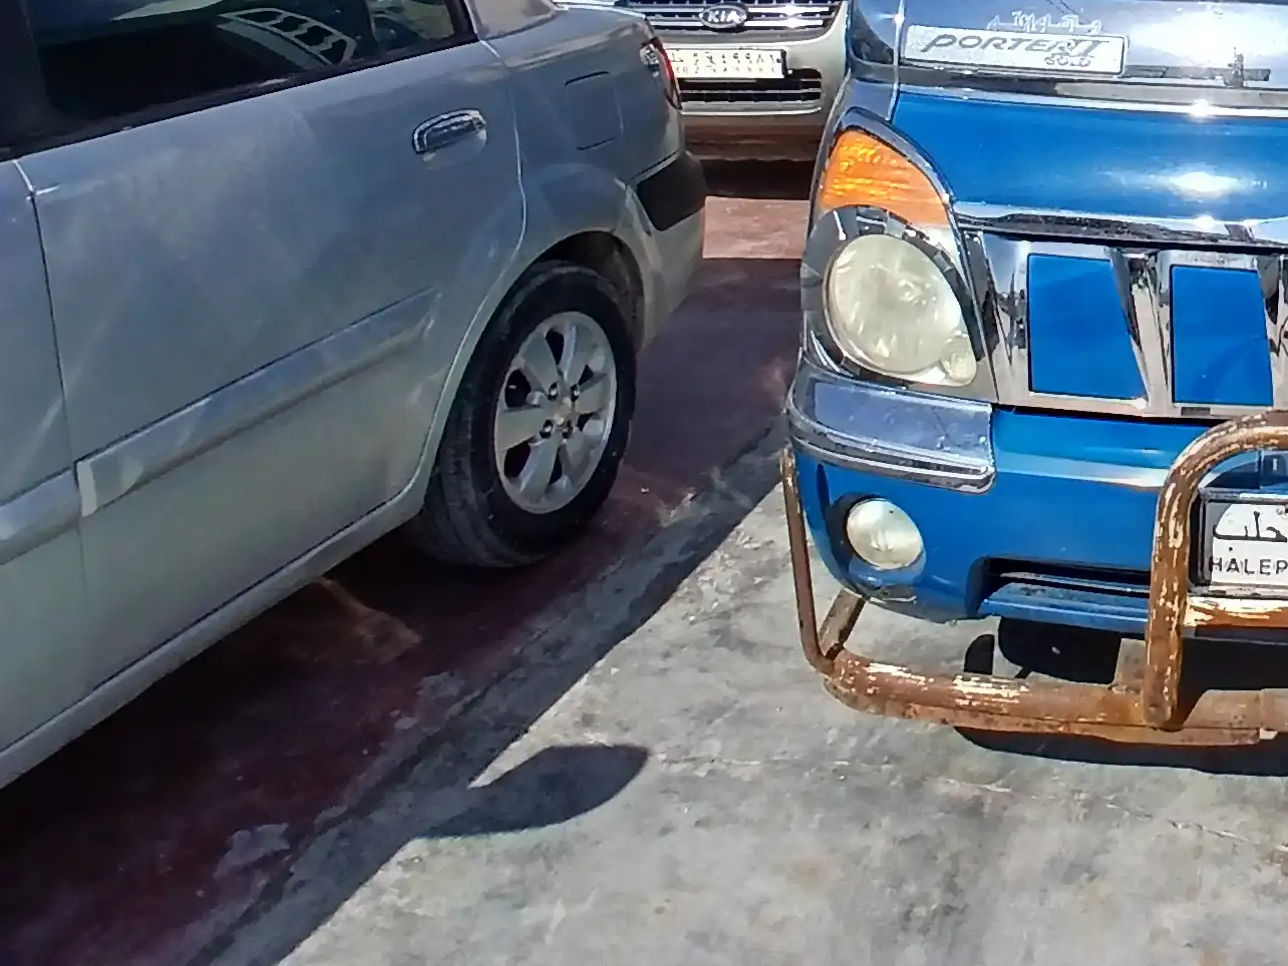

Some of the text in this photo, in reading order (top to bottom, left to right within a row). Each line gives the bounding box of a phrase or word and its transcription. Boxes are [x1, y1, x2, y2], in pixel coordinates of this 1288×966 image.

[708, 10, 741, 23] KIA
[1213, 511, 1287, 551] حلب
[1209, 556, 1288, 576] HALEP
